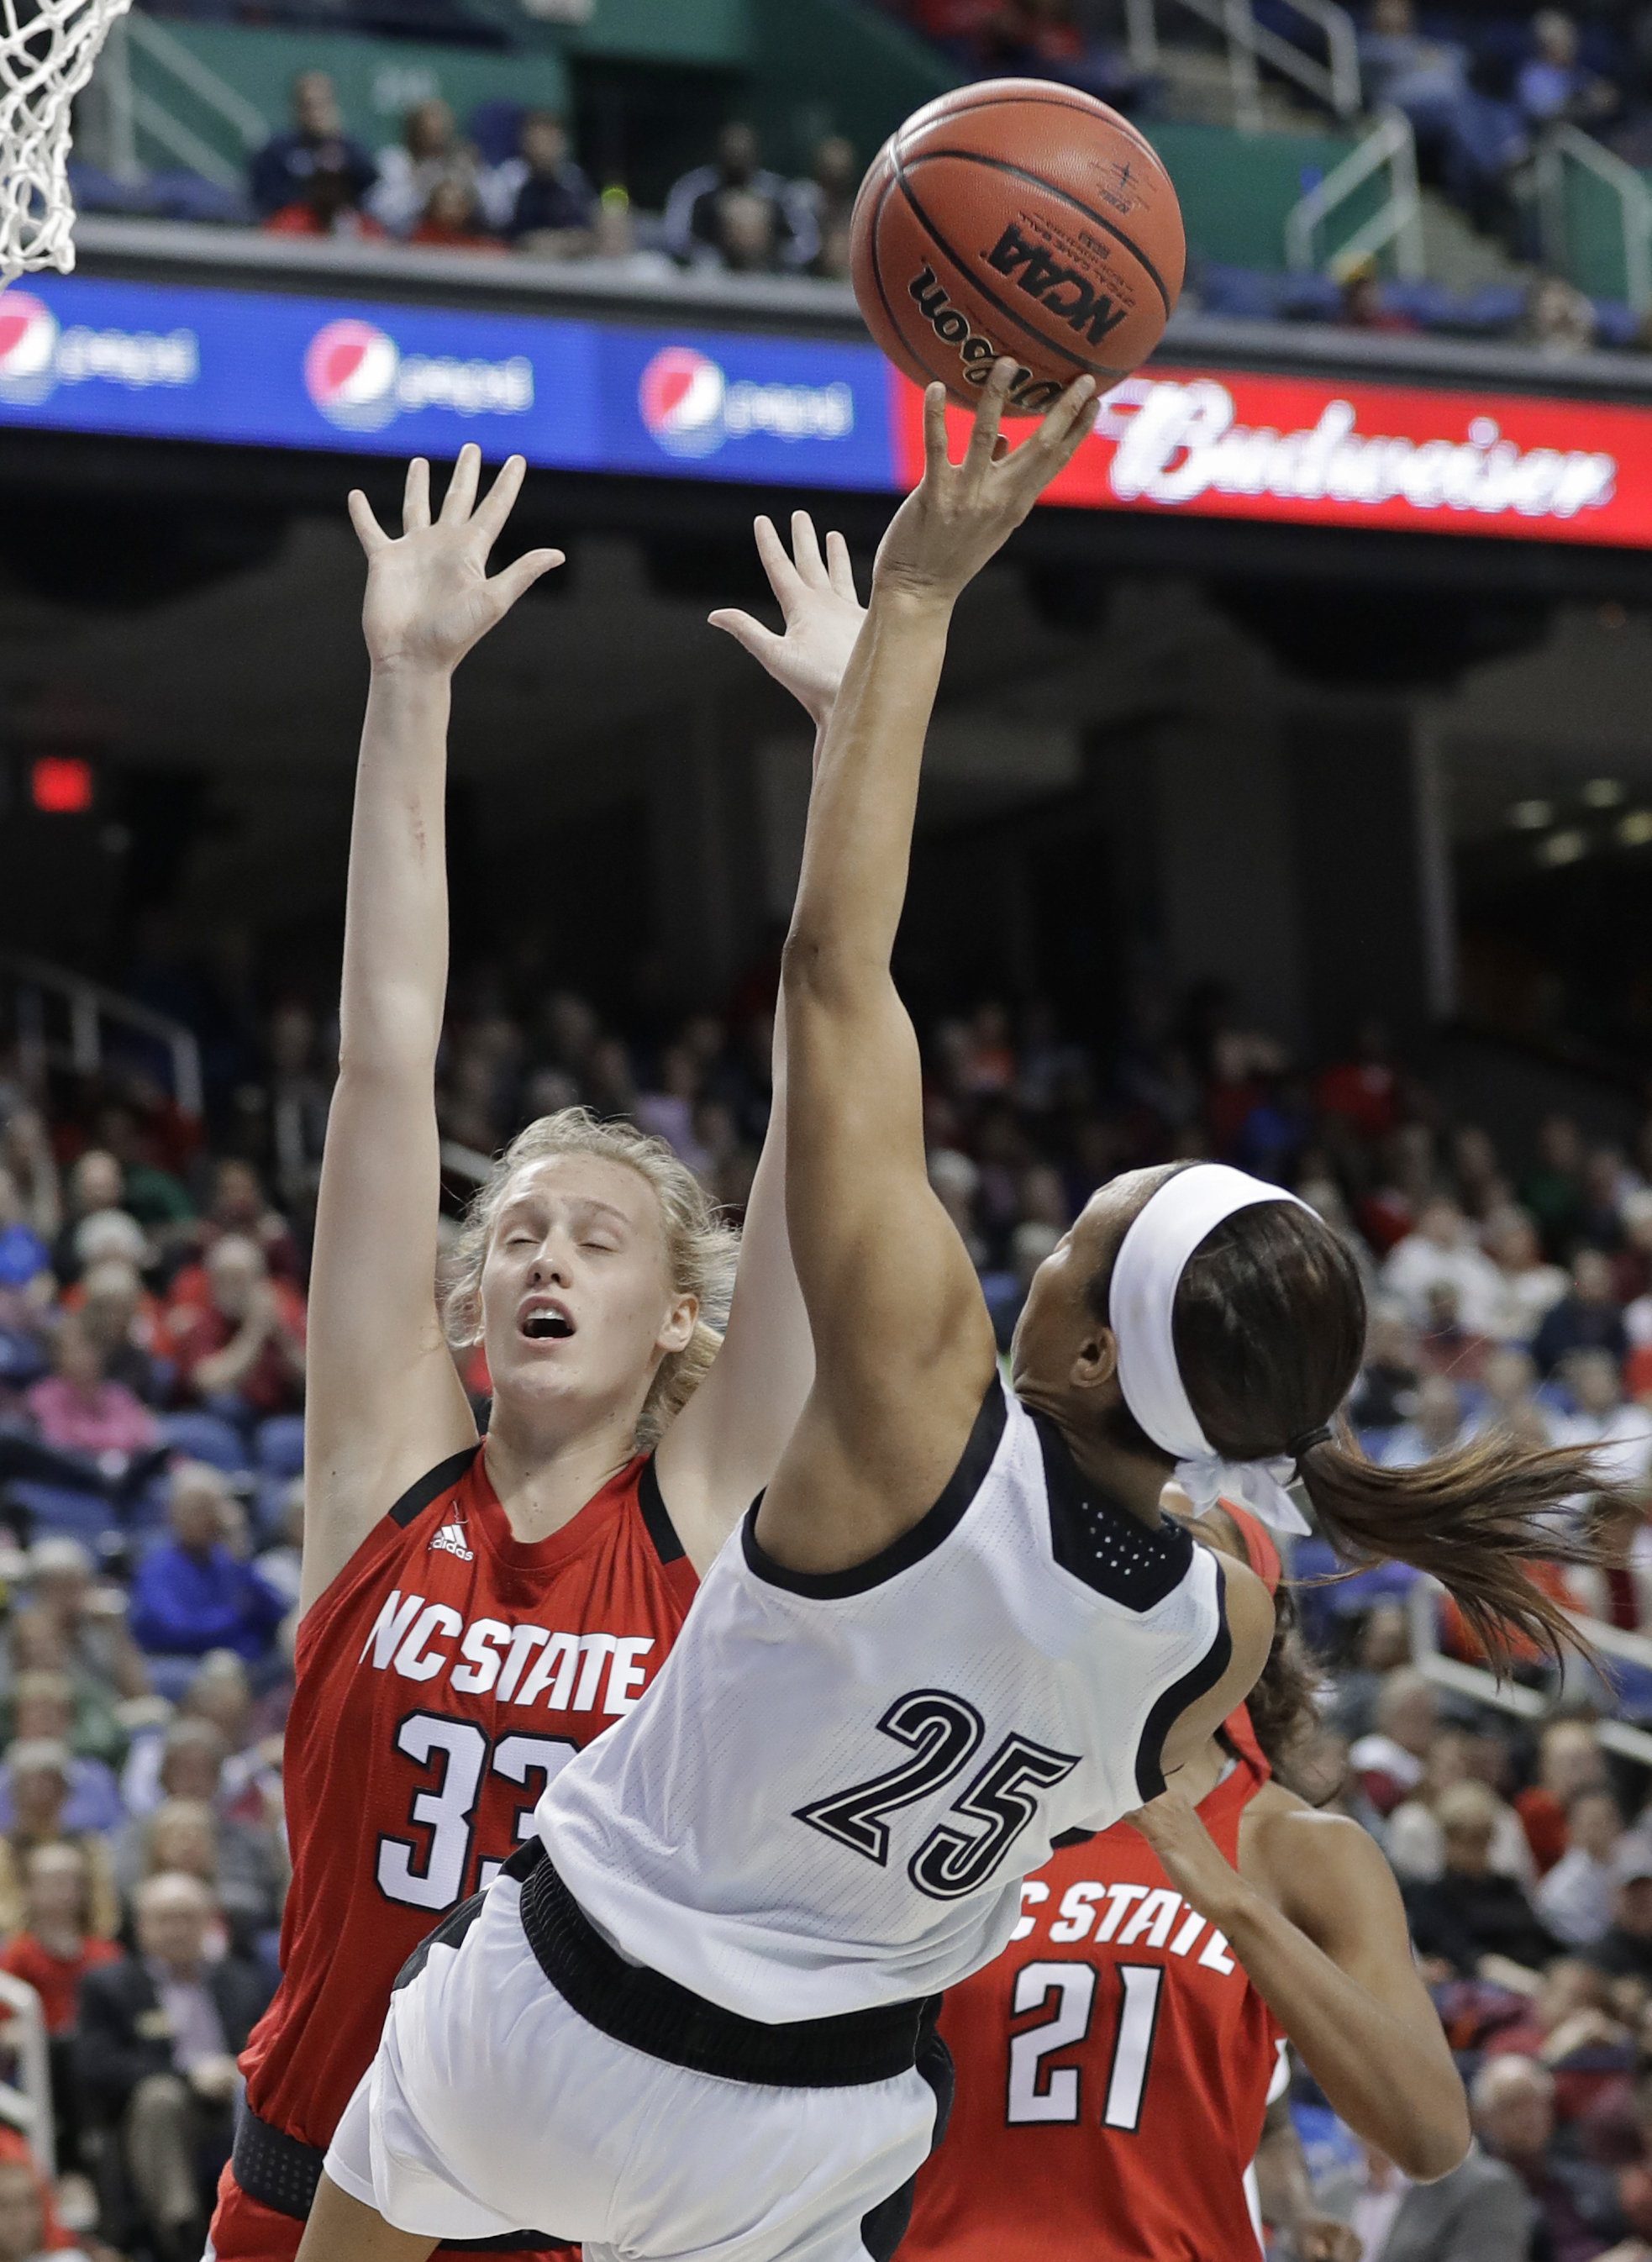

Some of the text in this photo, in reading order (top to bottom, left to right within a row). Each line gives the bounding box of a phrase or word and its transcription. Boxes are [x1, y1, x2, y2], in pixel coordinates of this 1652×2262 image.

[986, 224, 1127, 346] NCAA
[1095, 379, 1617, 518] Budweiser
[359, 1590, 655, 1715] NC STATE
[792, 1689, 1082, 1901] 25
[1006, 1959, 1165, 2134] 21
